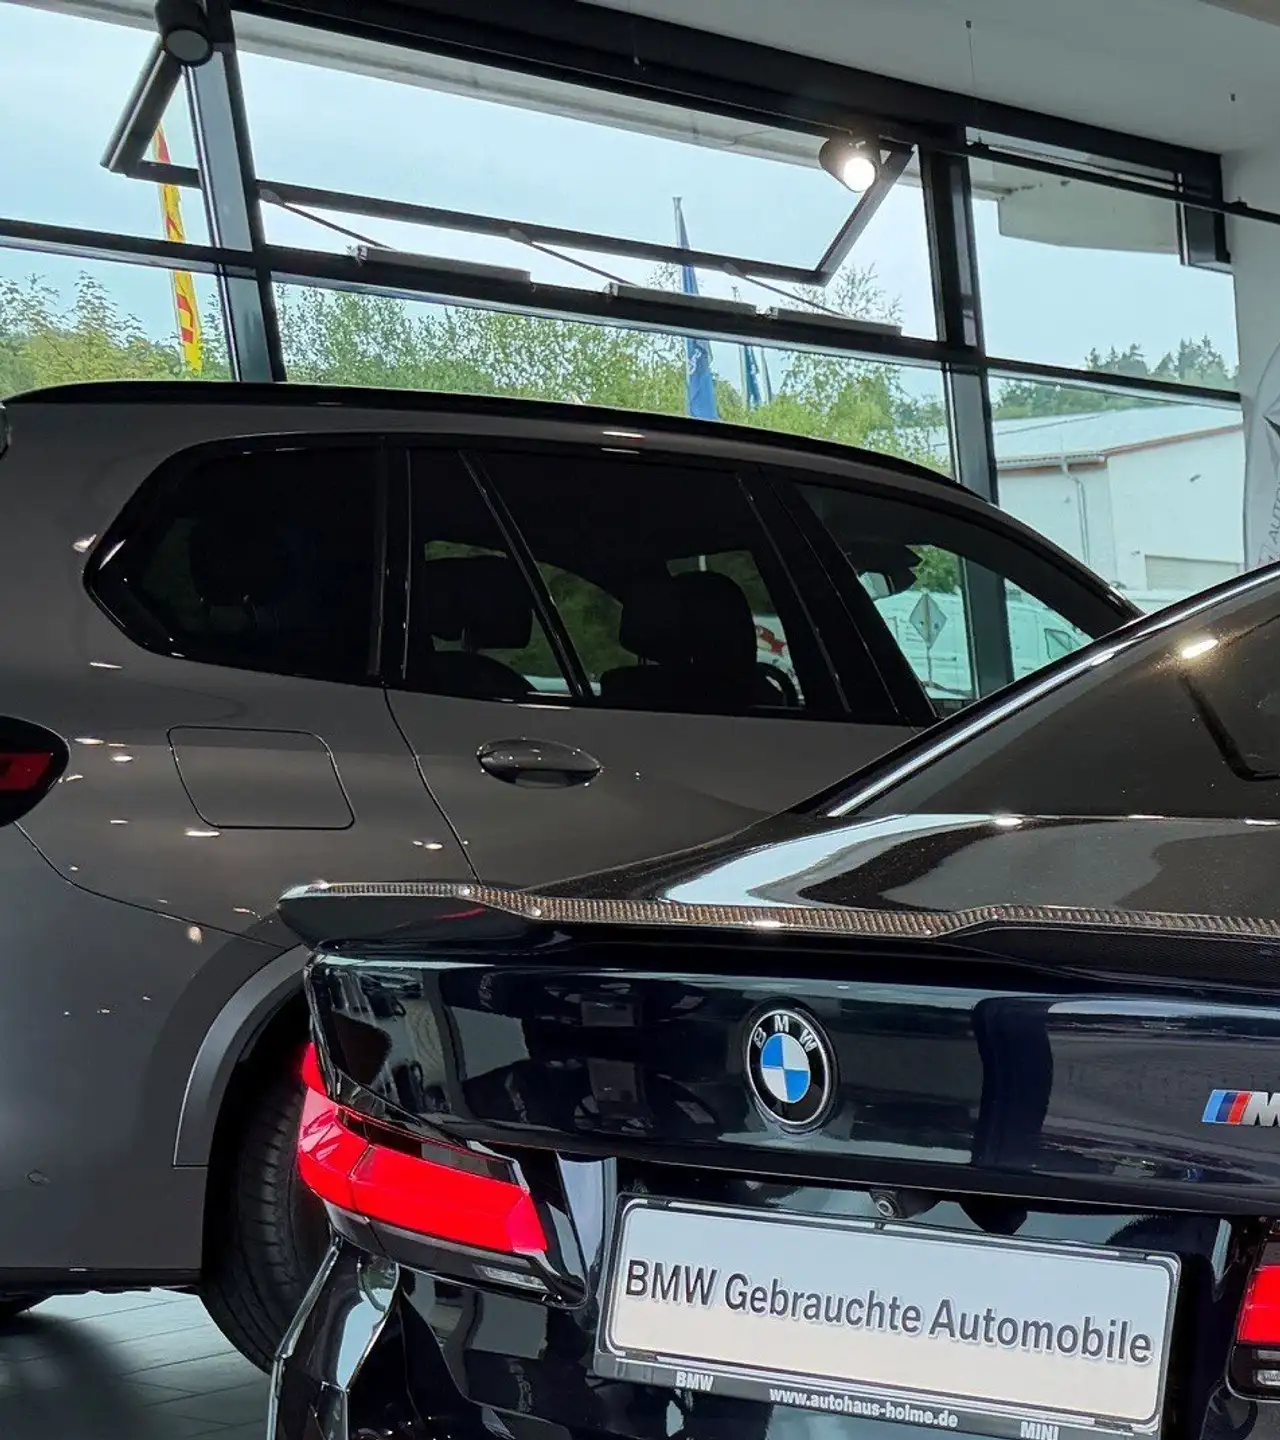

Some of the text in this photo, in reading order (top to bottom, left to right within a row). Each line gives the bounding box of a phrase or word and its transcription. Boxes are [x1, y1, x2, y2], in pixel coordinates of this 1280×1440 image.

[753, 1014, 818, 1053] BMW
[625, 1259, 1152, 1363] BMW Gebrauchte Automobile
[675, 1370, 714, 1392] BMW
[768, 1388, 960, 1429] www.autohaus-holme.de
